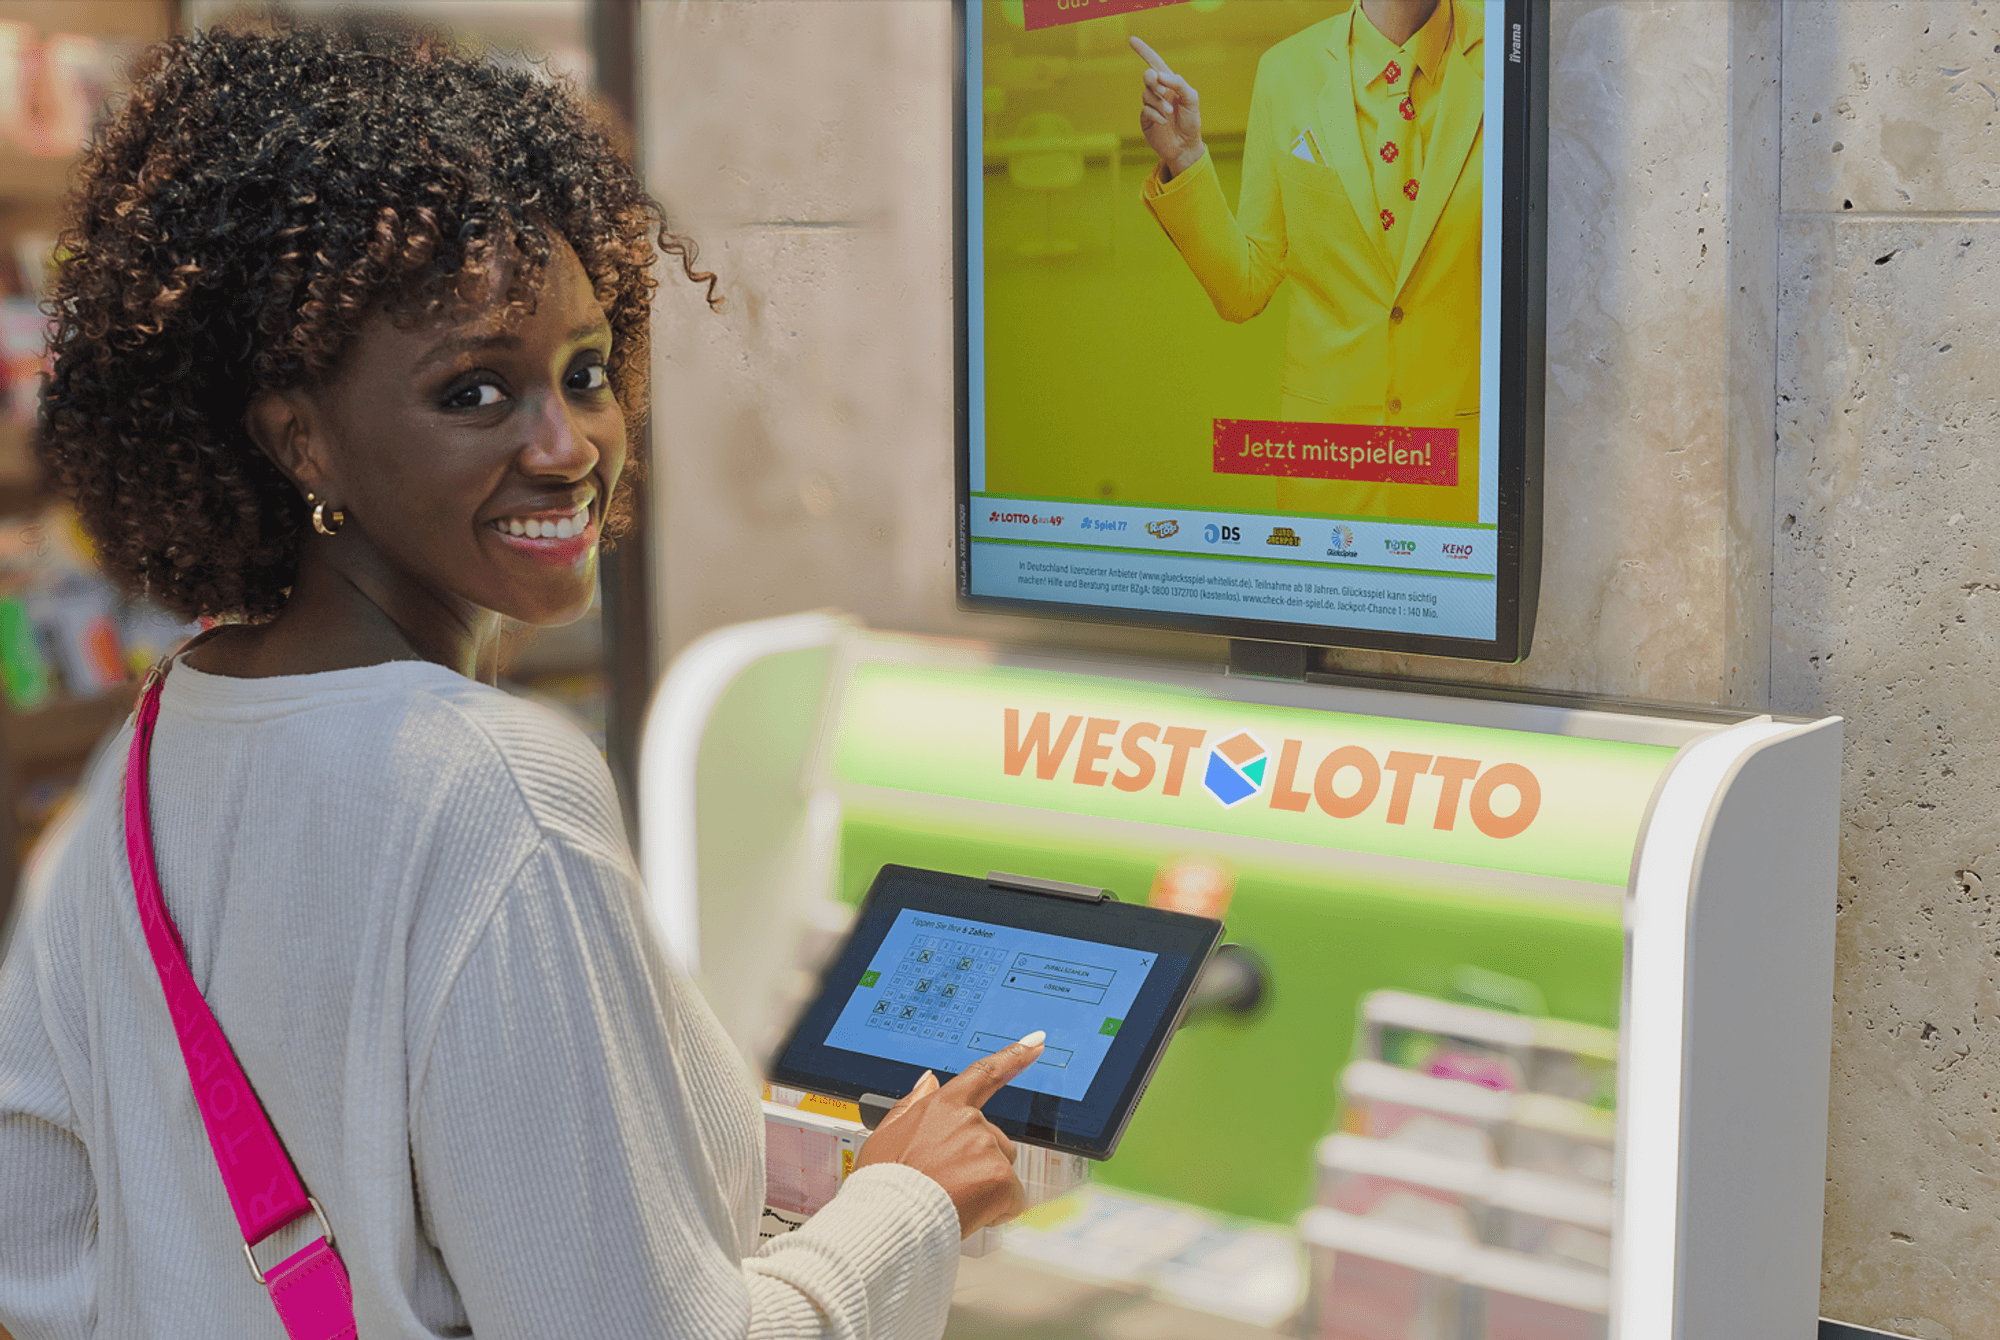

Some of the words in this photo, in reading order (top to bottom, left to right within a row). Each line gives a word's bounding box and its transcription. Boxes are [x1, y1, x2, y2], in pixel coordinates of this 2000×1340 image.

[1509, 23, 1521, 63] iiyama
[1238, 434, 1296, 459] Jetzt
[1302, 439, 1431, 469] mitspielen!
[1001, 513, 1030, 524] LOTTO
[1094, 520, 1117, 531] Spiel
[1117, 521, 1128, 531] 77
[1222, 526, 1240, 541] DS
[1384, 540, 1416, 552] TOTO
[1442, 543, 1473, 555] KENO
[1026, 561, 1068, 574] Deutschland
[1070, 564, 1107, 577] lizenzierter
[1108, 567, 1137, 579] Anbieter
[1255, 579, 1292, 592] Teilnahme
[1293, 583, 1303, 593] ab
[1304, 583, 1312, 593] 18
[1314, 584, 1340, 596] Jahren.
[1342, 586, 1385, 600] Glücksspiel
[1387, 589, 1406, 600] kann
[1408, 592, 1437, 605] süchtig
[1018, 575, 1047, 586] machen!
[1048, 576, 1063, 587] Hilfe
[1064, 578, 1077, 588] und
[1079, 579, 1109, 593] Beratung
[1111, 583, 1129, 592] unter
[1152, 585, 1169, 597] 0800
[1171, 587, 1199, 598] 1372700
[1337, 601, 1397, 616] Jackpot-Chance
[1408, 606, 1421, 617] 140
[1422, 608, 1438, 618] Mio.
[1003, 708, 1207, 797] WEST
[1269, 738, 1542, 839] LOTTO
[911, 917, 935, 928] Tippen
[935, 921, 946, 930] Sie
[947, 923, 961, 933] Ihre
